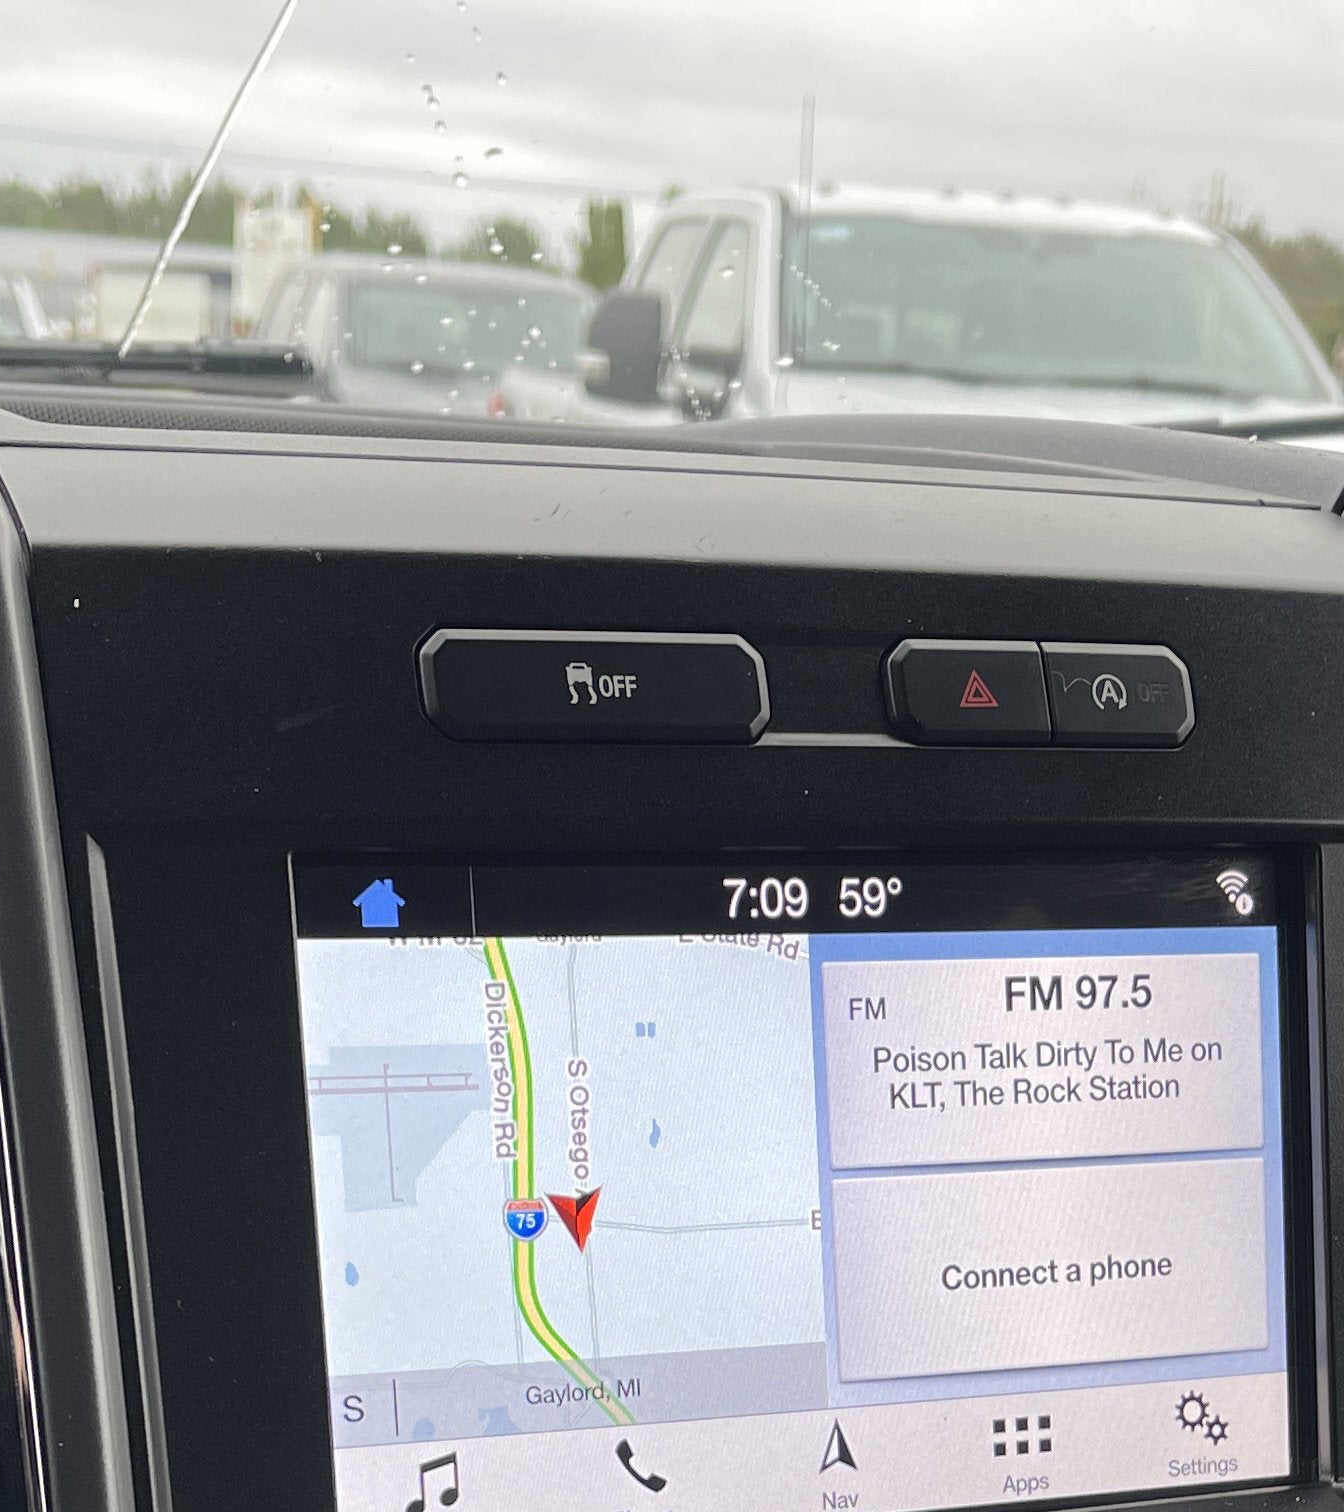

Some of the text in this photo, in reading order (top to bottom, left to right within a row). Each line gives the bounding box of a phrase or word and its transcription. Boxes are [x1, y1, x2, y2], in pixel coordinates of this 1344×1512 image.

[598, 673, 638, 700] OFF
[722, 876, 903, 920] 7:09 59°
[1003, 973, 1153, 1012] FM 97.5
[848, 997, 887, 1021] FM
[873, 1037, 1222, 1073] Poison Talk Dirty To Me on
[484, 982, 518, 1159] Dickerson Rd
[890, 1073, 1180, 1112] KLT, The Rock Station
[567, 1059, 590, 1180] S Otsego
[515, 1213, 537, 1230] 75
[941, 1254, 1173, 1290] Connect a phone
[525, 1378, 643, 1406] Gaylord, MI
[342, 1394, 366, 1423] S
[1167, 1454, 1239, 1479] Settings
[1002, 1473, 1050, 1496] Apps
[822, 1491, 859, 1511] Nav
